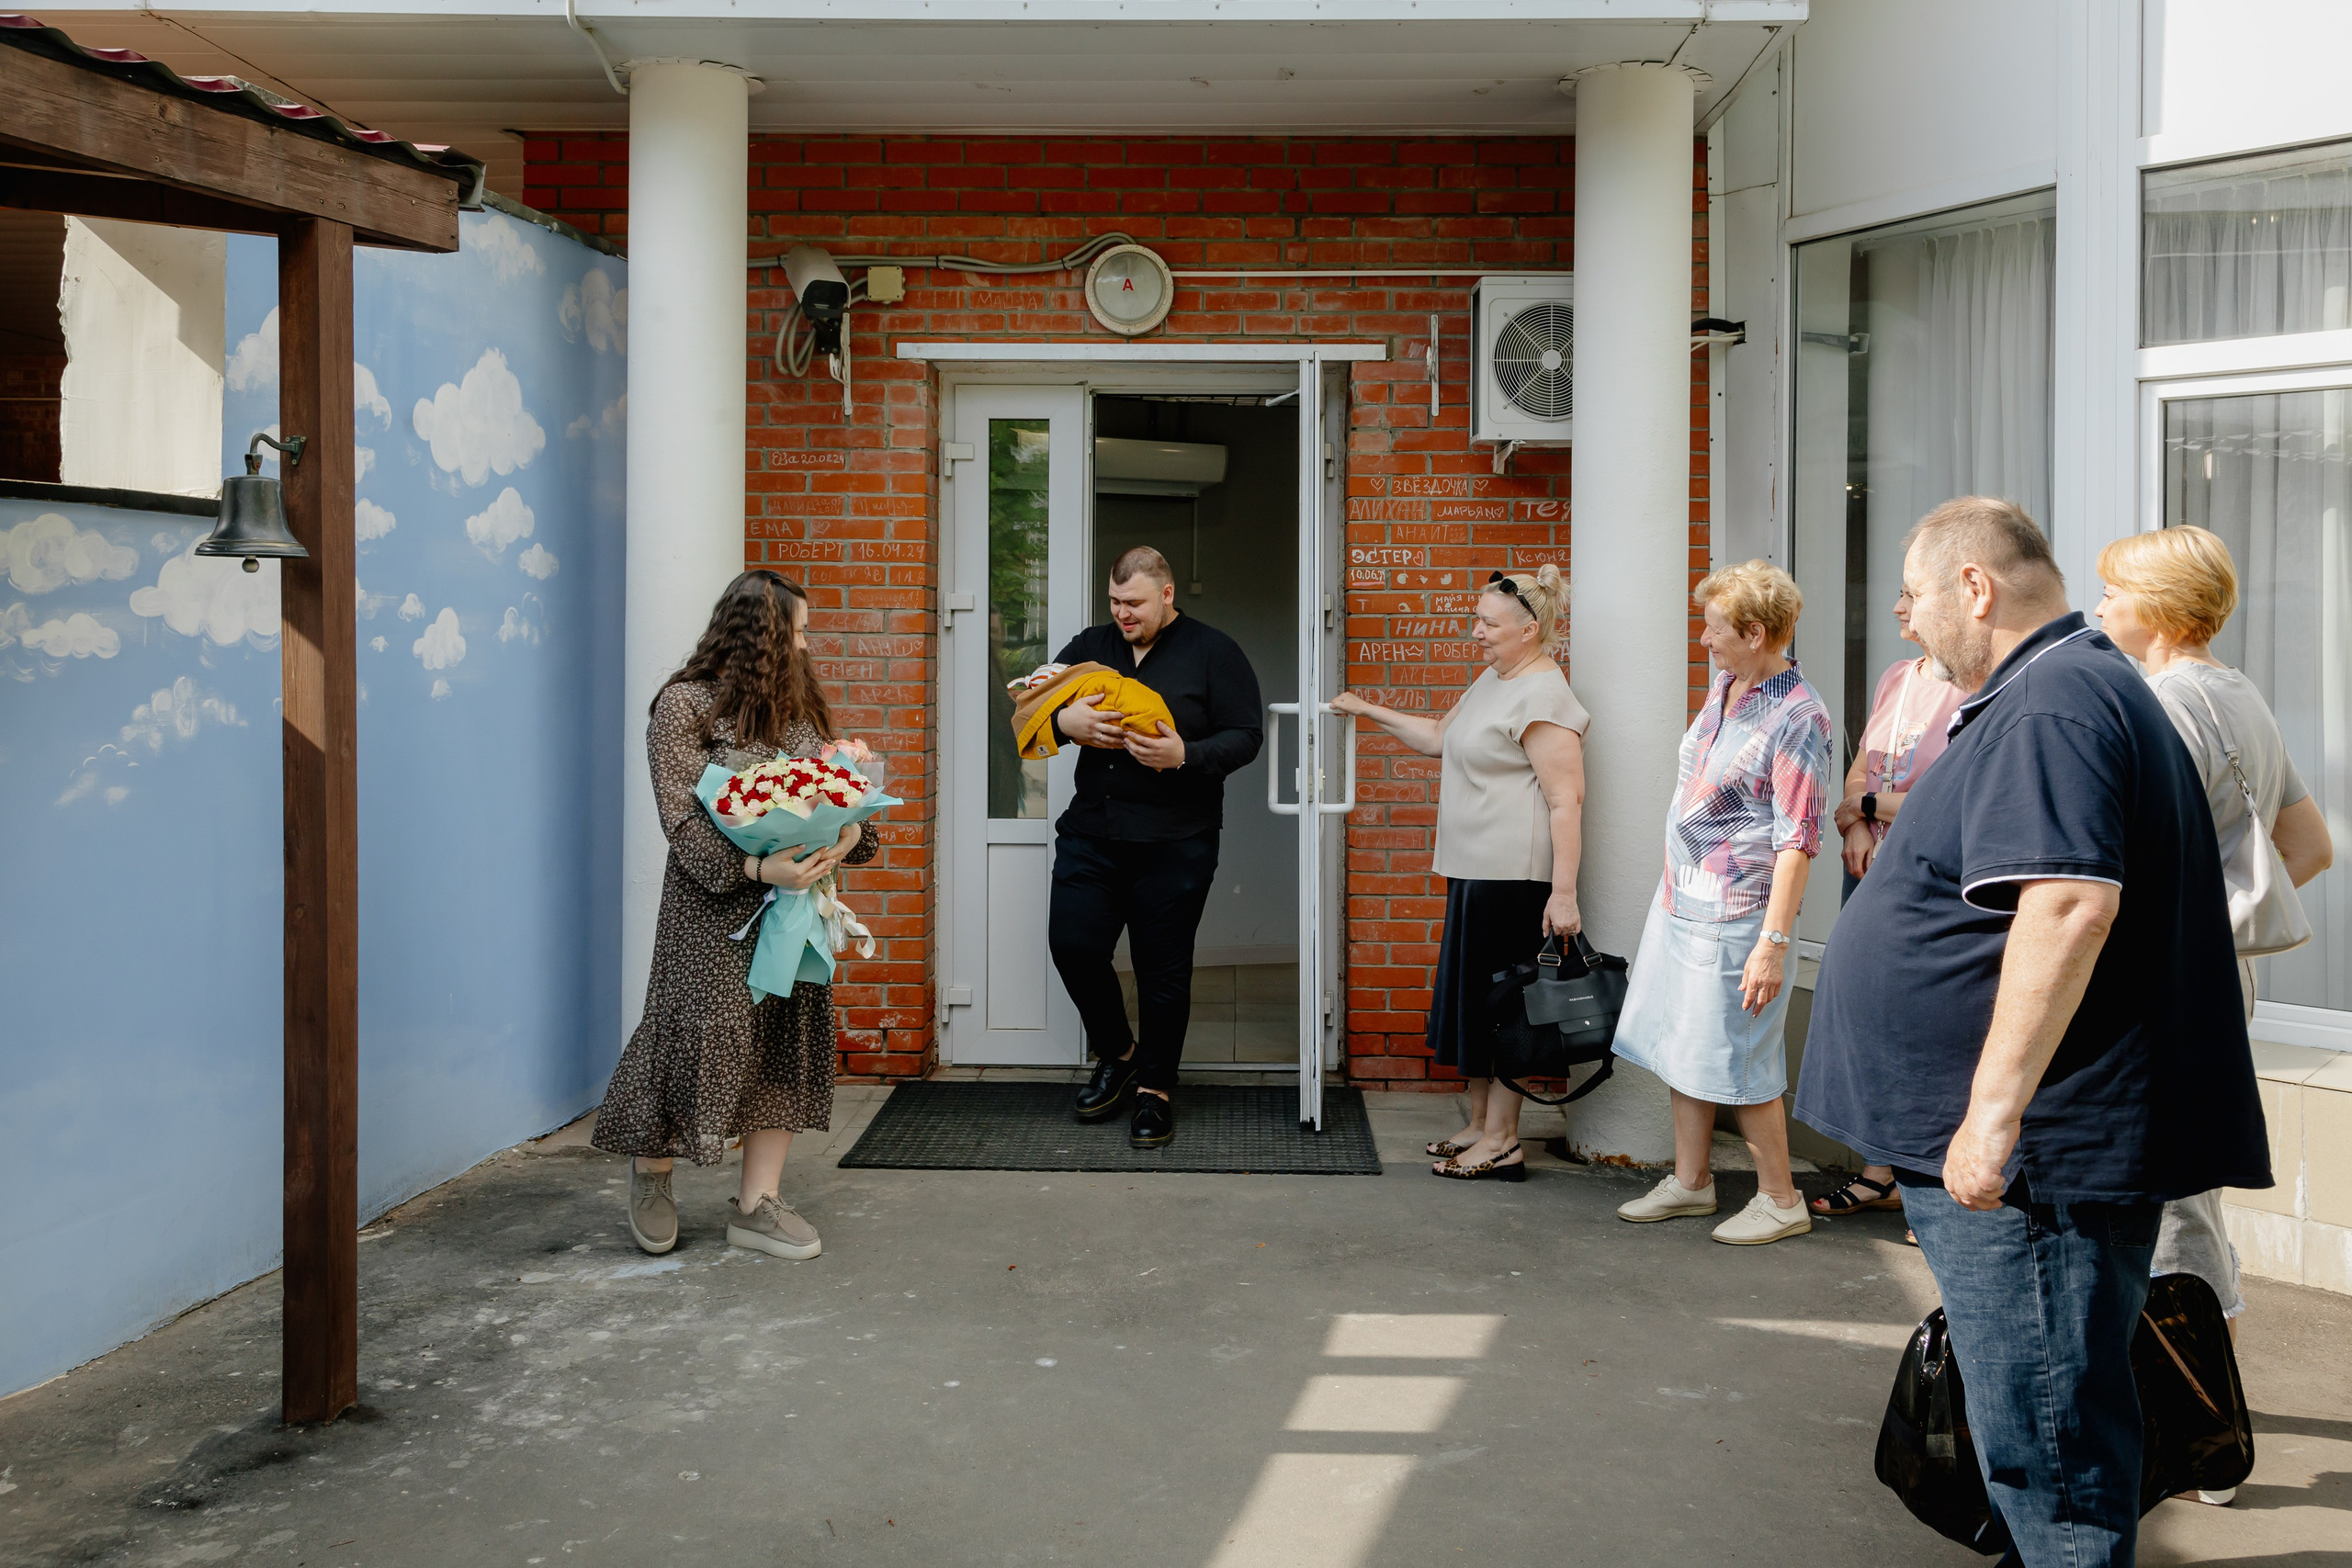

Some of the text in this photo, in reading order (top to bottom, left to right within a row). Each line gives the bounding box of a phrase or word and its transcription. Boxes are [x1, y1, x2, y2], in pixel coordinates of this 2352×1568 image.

[1122, 278, 1135, 291] А
[1393, 477, 1468, 496] ЗВЁЗДОЧКА
[745, 521, 794, 537] ЕМА
[1396, 525, 1449, 543] АНАИТ
[1351, 547, 1412, 565] ЭСТЕР
[1396, 619, 1460, 636] НИНА
[1360, 642, 1406, 662] АРЕН
